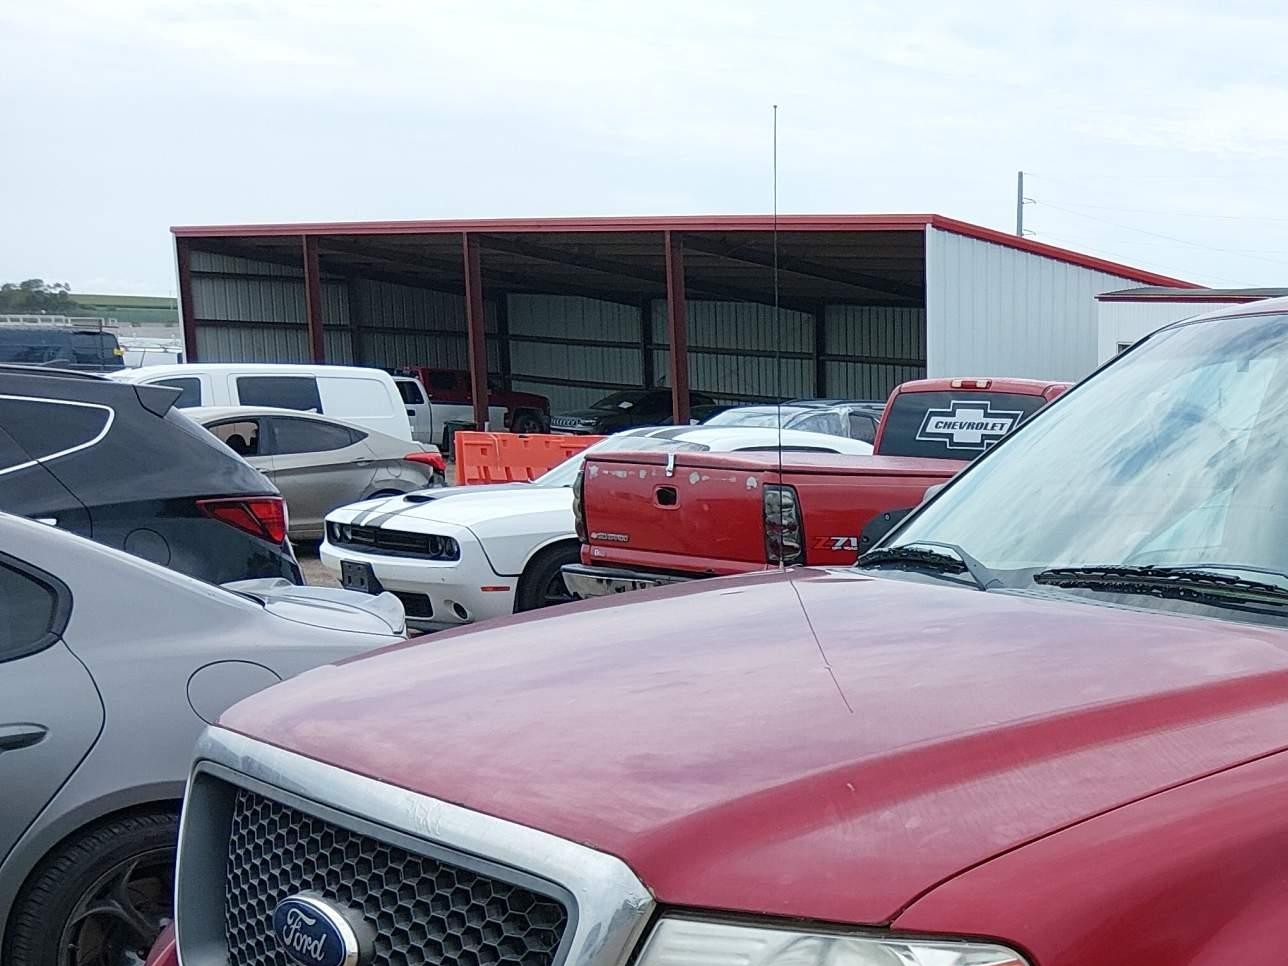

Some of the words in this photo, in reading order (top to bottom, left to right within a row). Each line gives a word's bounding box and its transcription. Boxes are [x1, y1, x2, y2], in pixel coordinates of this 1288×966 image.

[934, 419, 1008, 432] CHEVROLET
[813, 536, 859, 550] Z71
[282, 908, 328, 961] Ford
